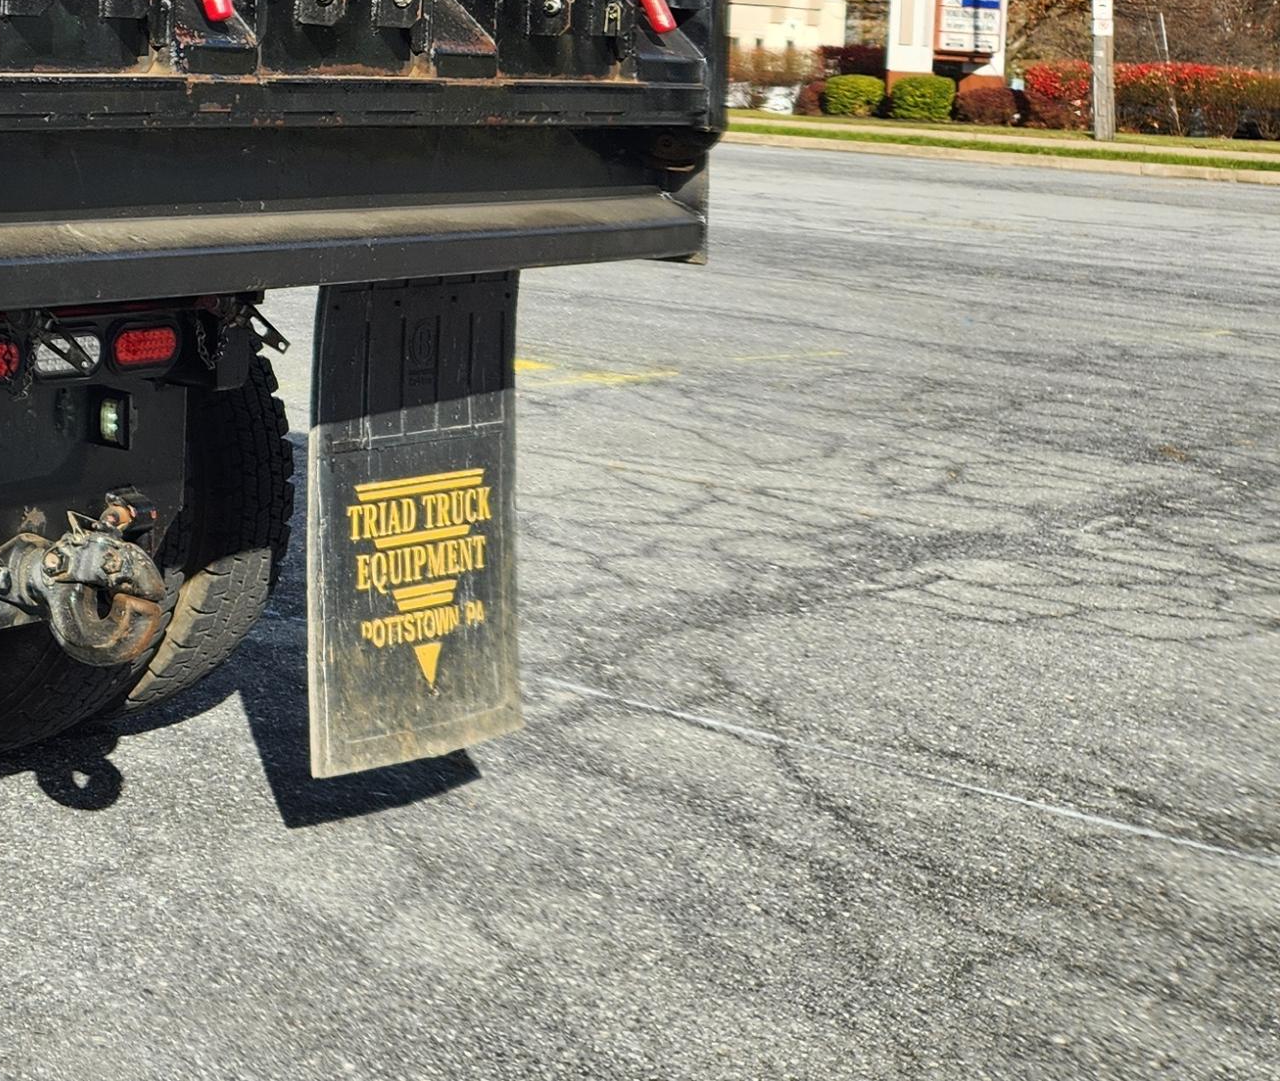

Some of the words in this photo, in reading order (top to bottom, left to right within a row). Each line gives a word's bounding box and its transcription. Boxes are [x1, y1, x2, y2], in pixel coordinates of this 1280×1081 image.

[346, 497, 417, 541] TRIAD
[422, 486, 492, 528] TRUCK
[355, 535, 487, 594] EQUIPMENT
